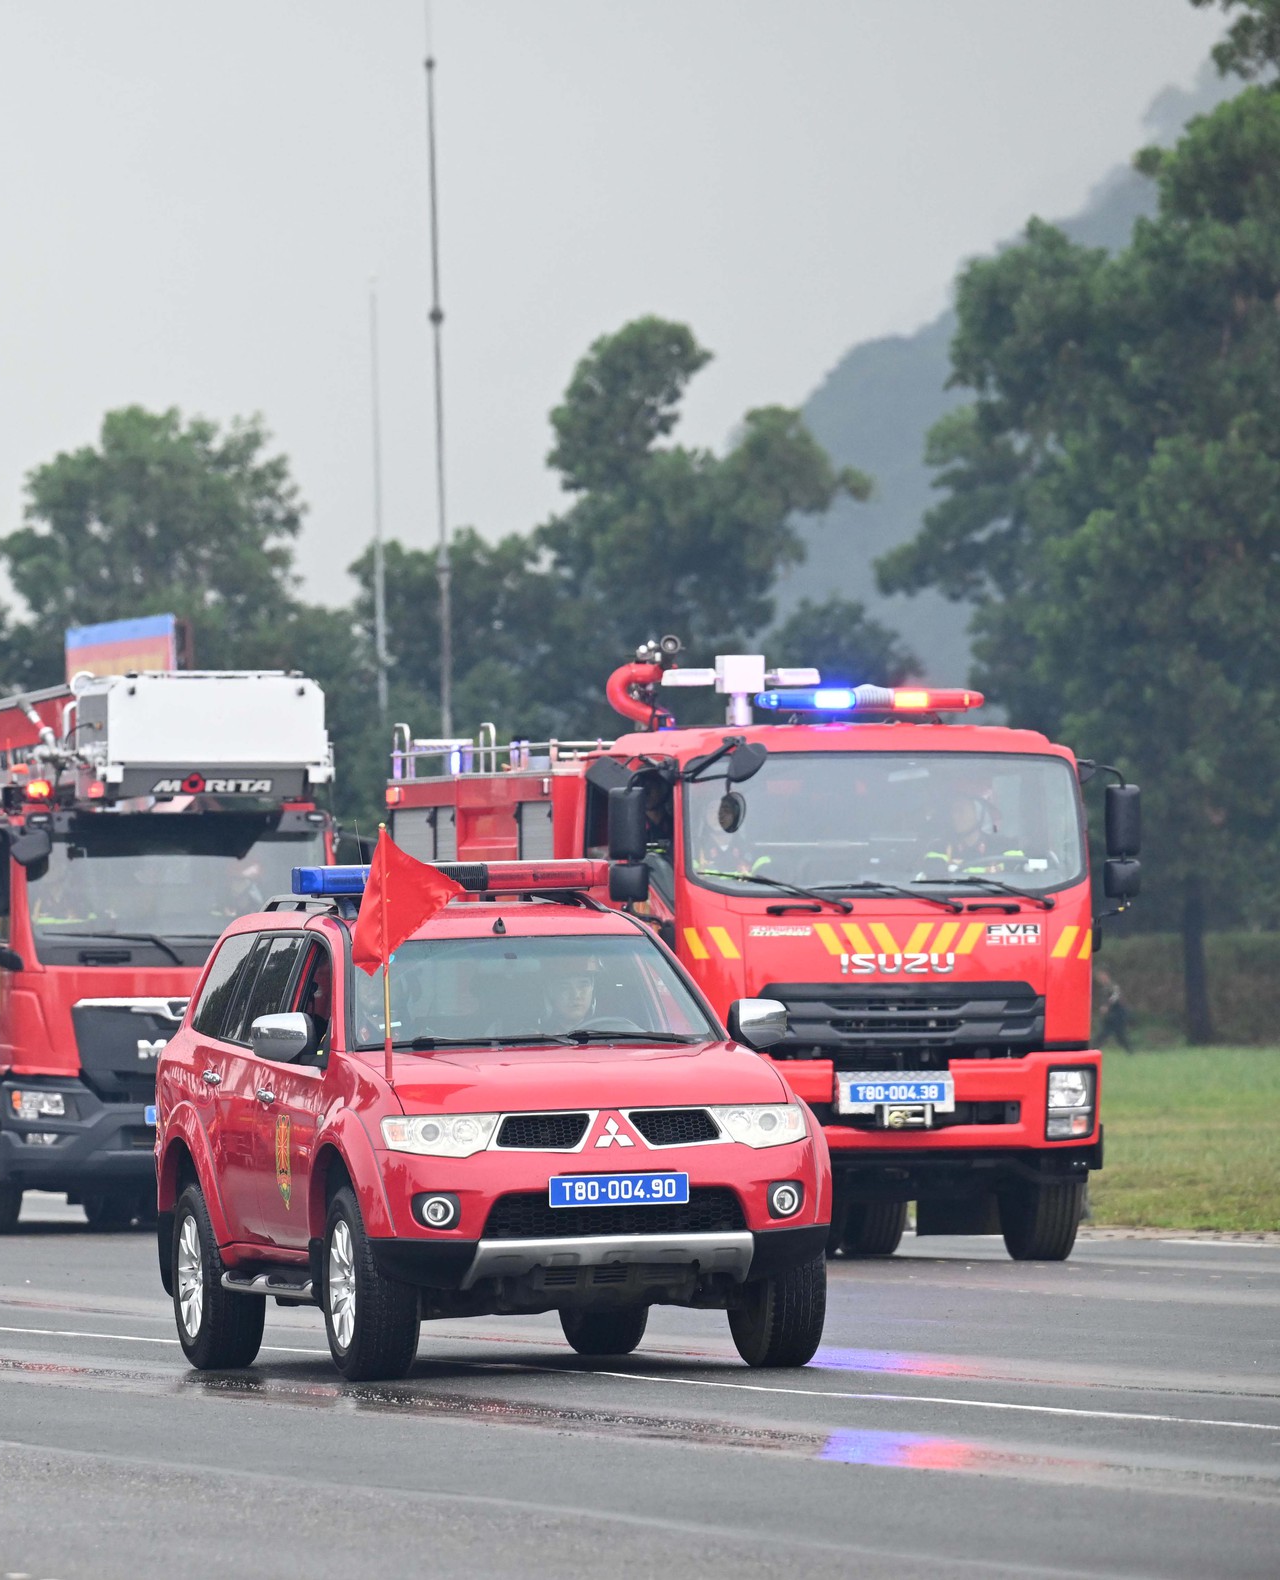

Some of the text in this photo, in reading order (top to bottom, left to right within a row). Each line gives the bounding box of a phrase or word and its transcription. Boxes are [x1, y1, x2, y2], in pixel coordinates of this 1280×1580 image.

[151, 772, 272, 794] MORITA
[987, 924, 1039, 935] FVR
[840, 952, 955, 975] ISUZU
[856, 1085, 939, 1101] T80-004.38
[561, 1178, 676, 1201] T80-004.90
